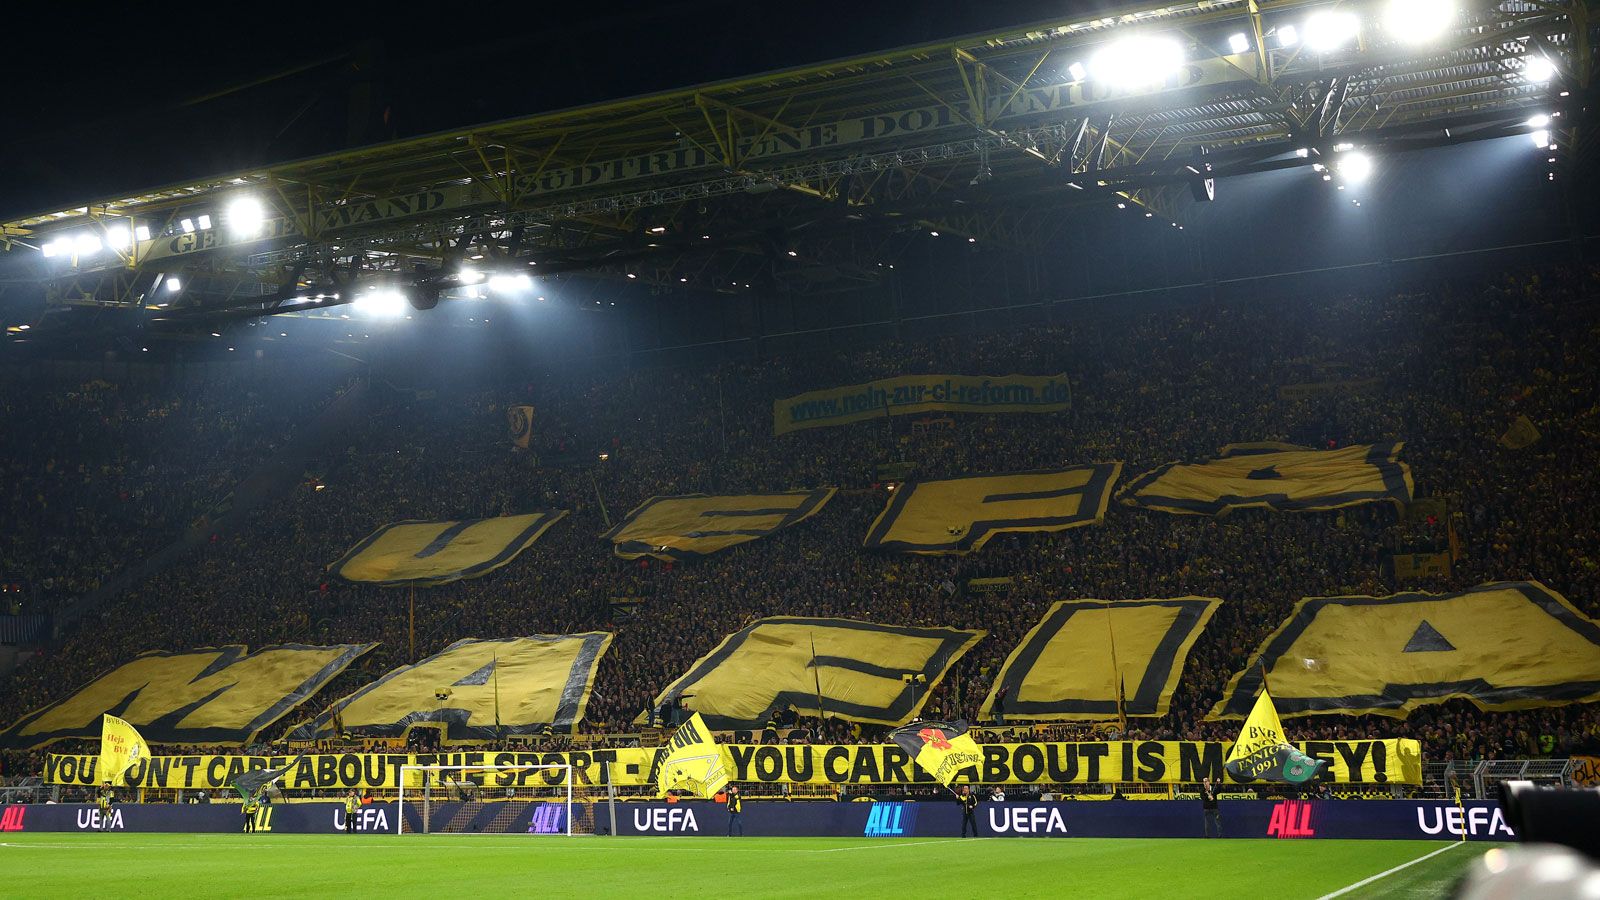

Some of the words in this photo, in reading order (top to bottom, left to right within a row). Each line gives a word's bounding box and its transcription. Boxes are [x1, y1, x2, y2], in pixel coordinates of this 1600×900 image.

[790, 379, 1069, 420] www.nein-zur-cl-reform.de
[46, 755, 96, 784] YOU
[122, 756, 201, 788] ON'T
[295, 755, 408, 787] ABOUT
[416, 753, 485, 787] THE
[494, 750, 617, 786] SPORT
[728, 746, 815, 782] YOU
[1121, 743, 1165, 781] IS
[1180, 740, 1387, 783] MEY!
[1251, 757, 1278, 777] 1991
[528, 805, 562, 833] ALL
[633, 808, 699, 831] UEFA
[864, 804, 905, 835] ALL
[989, 807, 1068, 833] UEFA
[1266, 804, 1317, 837] ALL
[1417, 806, 1515, 836] UEFA
